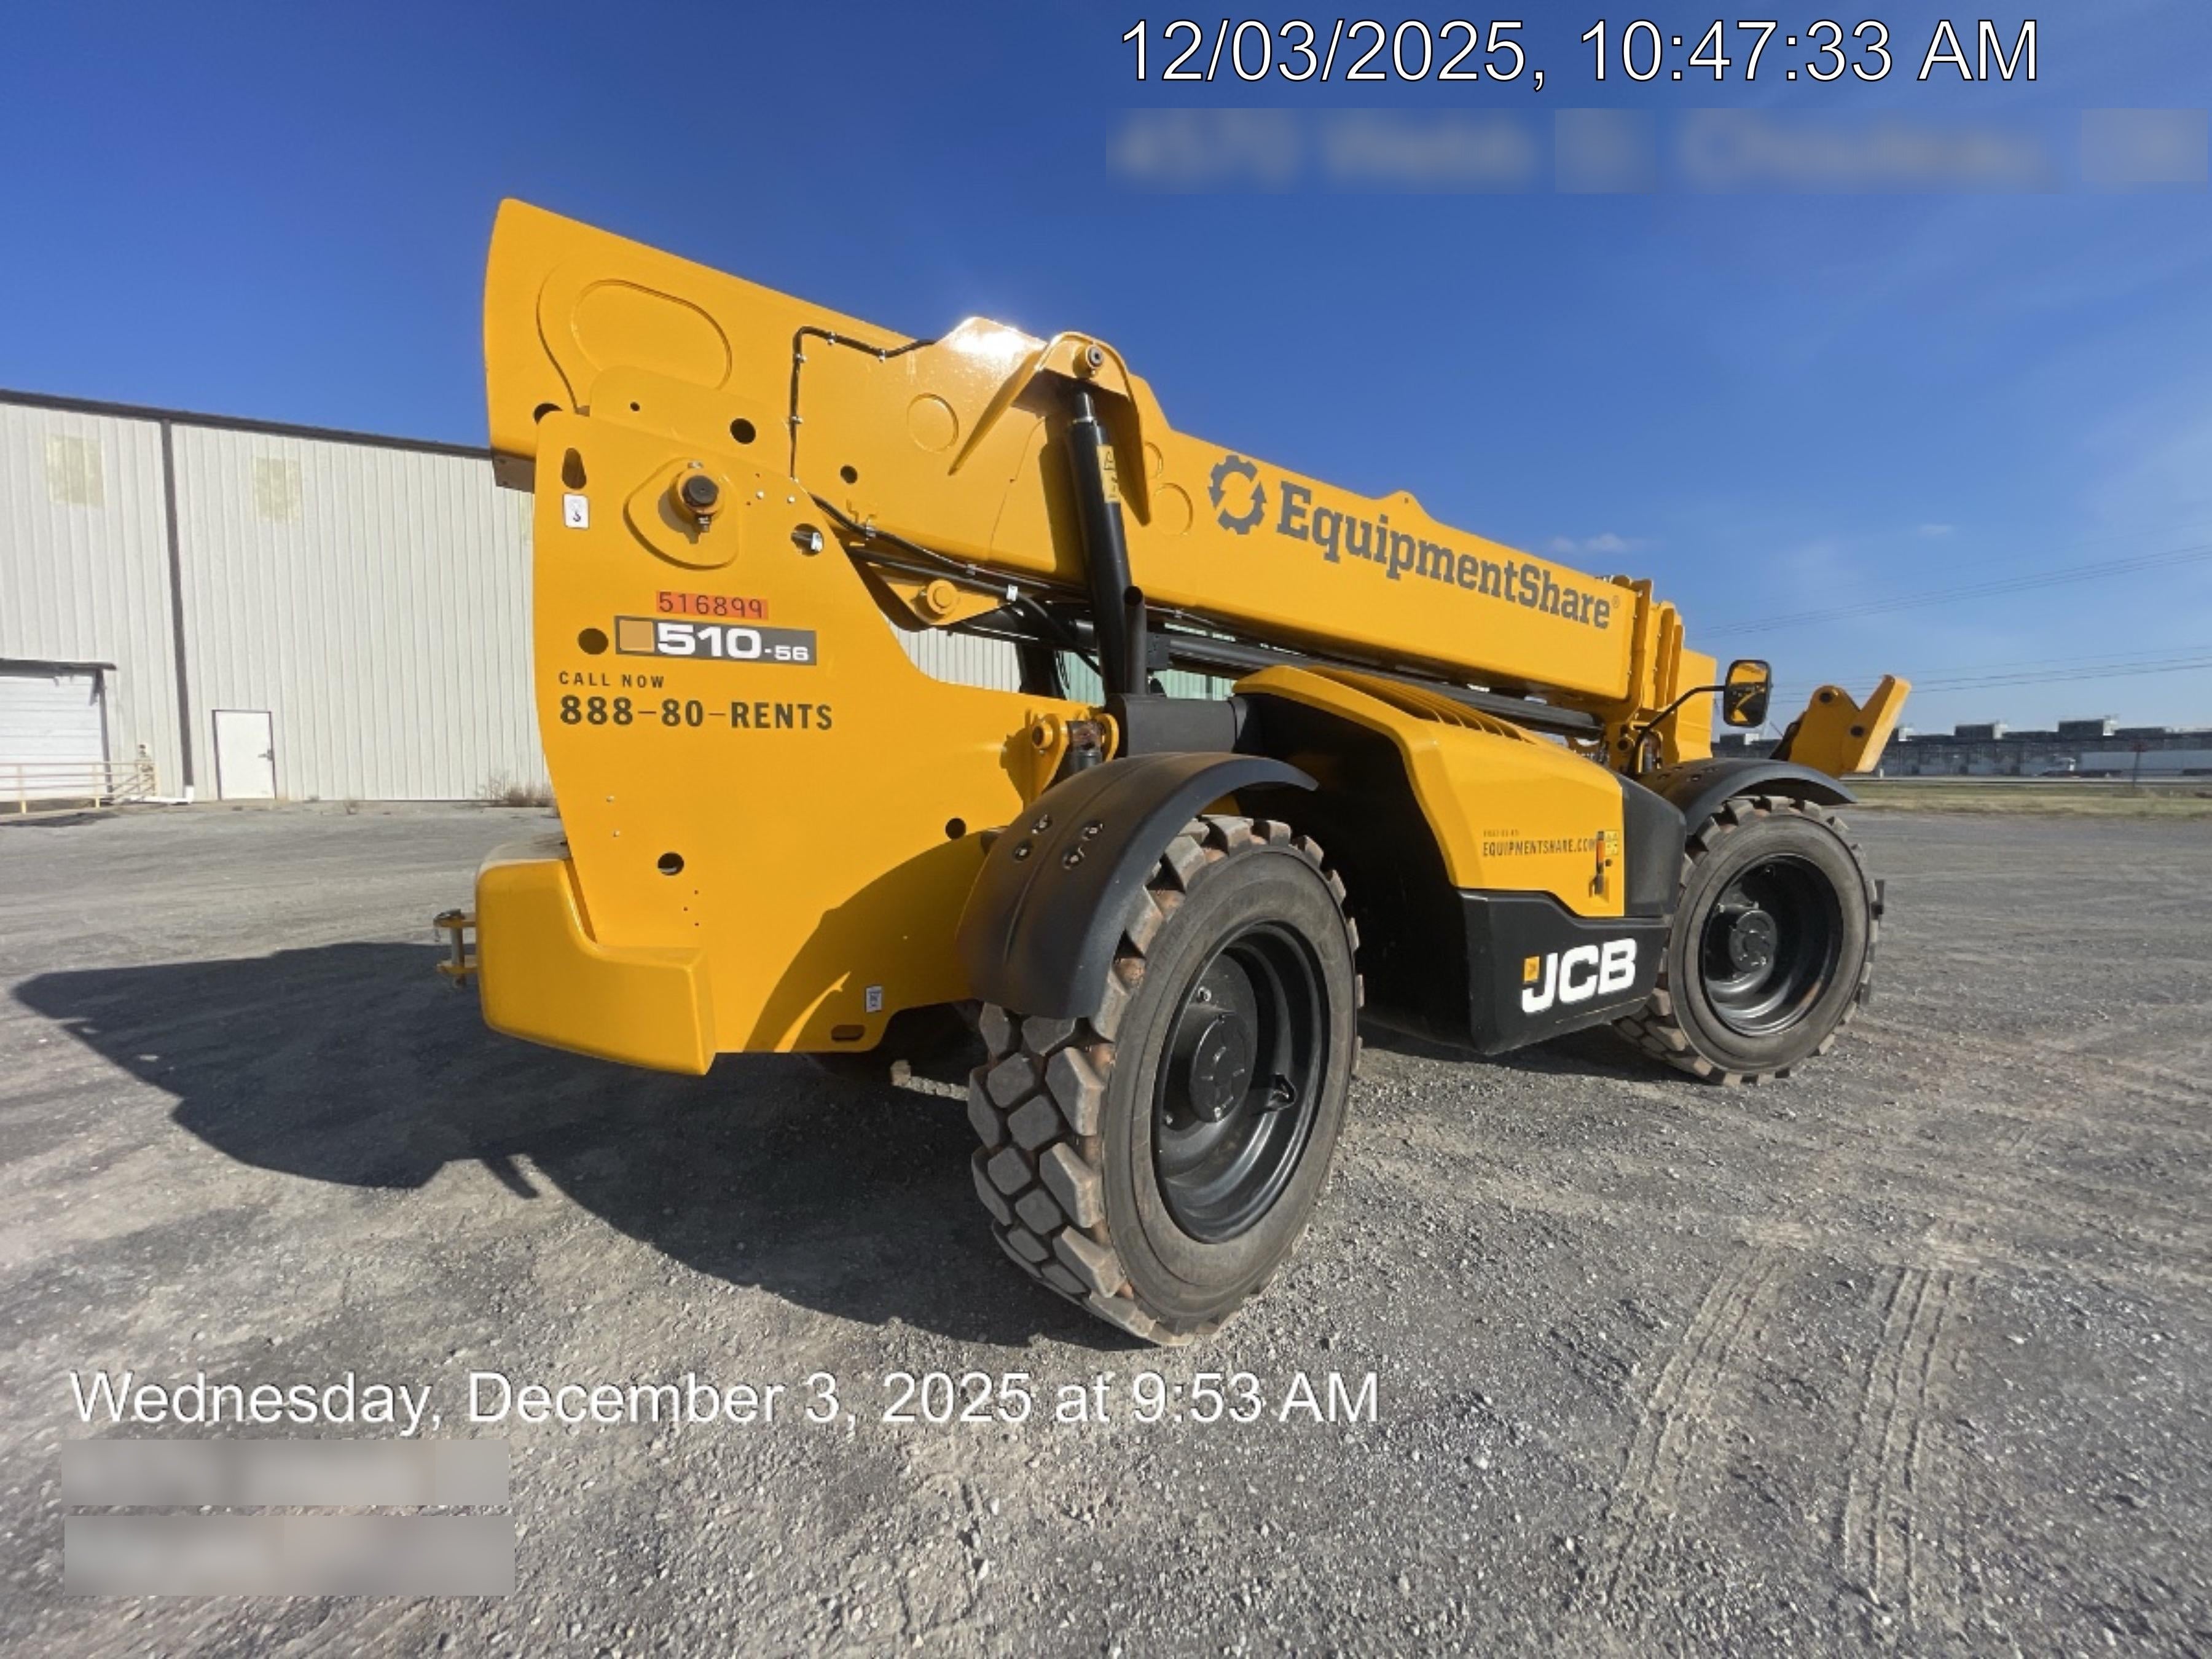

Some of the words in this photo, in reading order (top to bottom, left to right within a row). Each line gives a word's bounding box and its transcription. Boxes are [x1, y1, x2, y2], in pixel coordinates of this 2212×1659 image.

[1276, 480, 1610, 629] EquipmentShare
[659, 591, 763, 619] 516899
[657, 621, 809, 662] 510-56
[559, 670, 611, 687] CALL
[622, 673, 665, 689] NOW
[560, 694, 833, 731] 888-80-RENTS
[1521, 938, 1637, 1013] JCB
